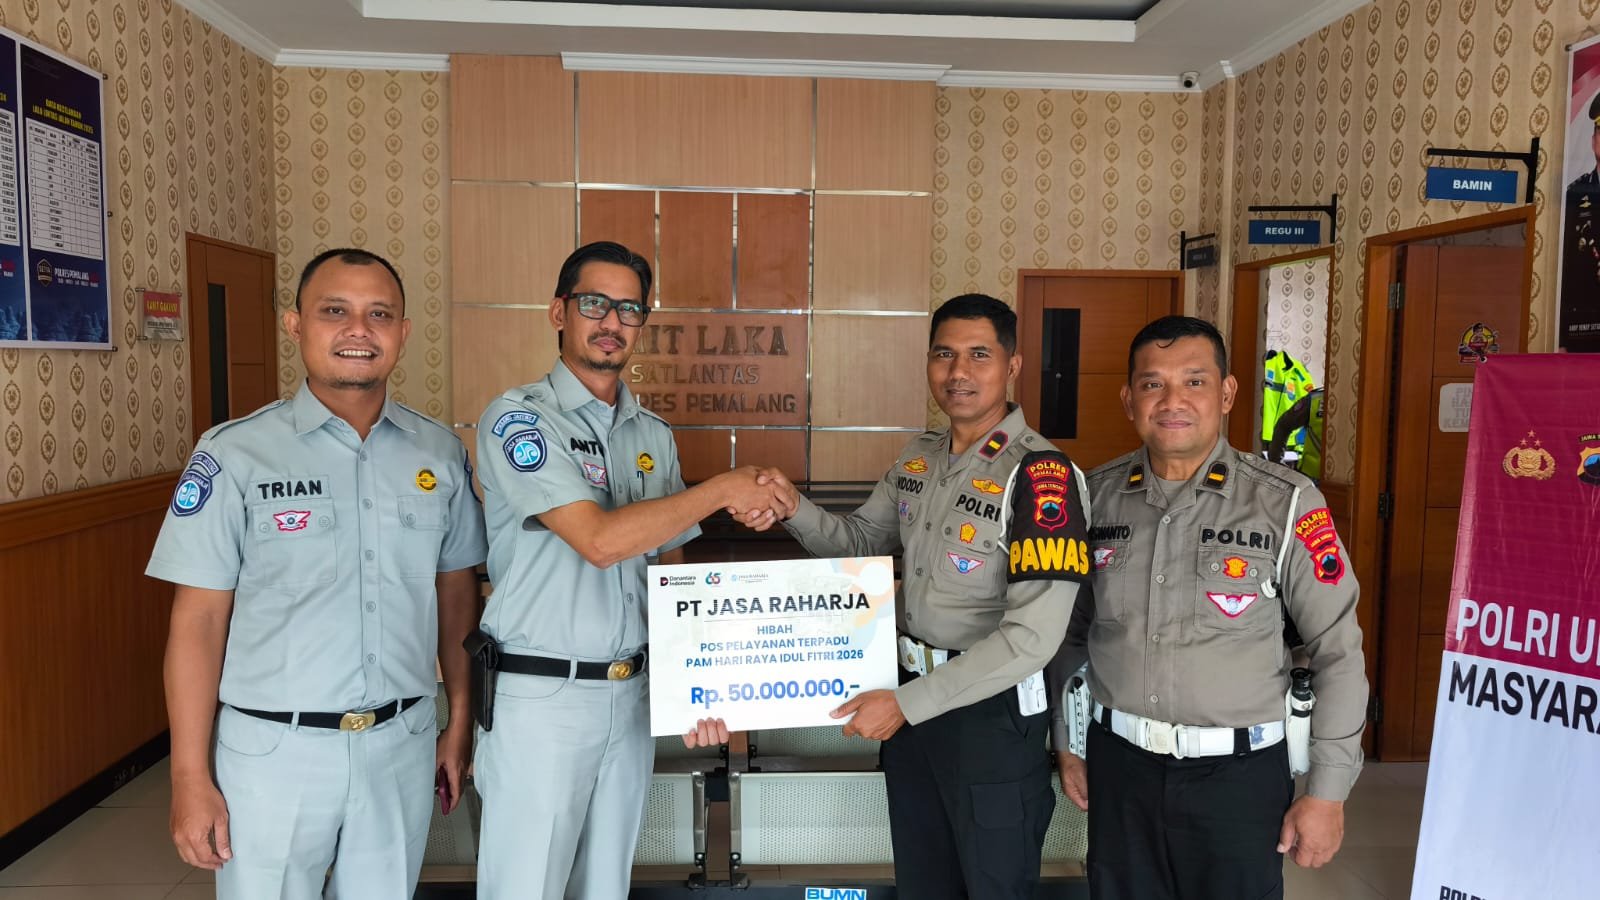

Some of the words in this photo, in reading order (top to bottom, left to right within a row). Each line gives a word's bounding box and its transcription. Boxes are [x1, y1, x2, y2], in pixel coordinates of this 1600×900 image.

[1453, 180, 1492, 191] BAMIN
[1265, 227, 1292, 235] REGU
[1294, 227, 1304, 235] III
[696, 325, 788, 356] LAKA
[631, 363, 760, 385] SATLANTAS
[638, 393, 677, 412] RES
[686, 393, 796, 414] PEMALANG
[1030, 462, 1066, 474] POLRES
[258, 479, 323, 500] TRIAN
[955, 494, 1001, 522] POLRI
[1296, 511, 1328, 535] POLRES
[1201, 528, 1270, 550] POLRI
[1009, 537, 1090, 575] PAWAS
[705, 571, 722, 585] 65
[676, 600, 702, 617] PT
[707, 597, 764, 616] JASA
[769, 593, 870, 613] RAHARJA
[757, 624, 793, 635] HIBAH
[1455, 599, 1560, 658] POLRI
[700, 642, 724, 653] POS
[726, 639, 795, 651] PELAYANAN
[798, 636, 850, 647] TERPADU
[686, 657, 712, 668] PAM
[715, 655, 743, 666] HARI
[745, 654, 778, 665] RAYA
[779, 652, 805, 663] IDUL
[807, 650, 834, 661] FITRI
[837, 649, 864, 660] 2026
[691, 687, 724, 709] Rp.
[728, 678, 860, 702] 50.000.000,-
[1448, 660, 1600, 735] MASYAR
[807, 888, 866, 900] BUMN
